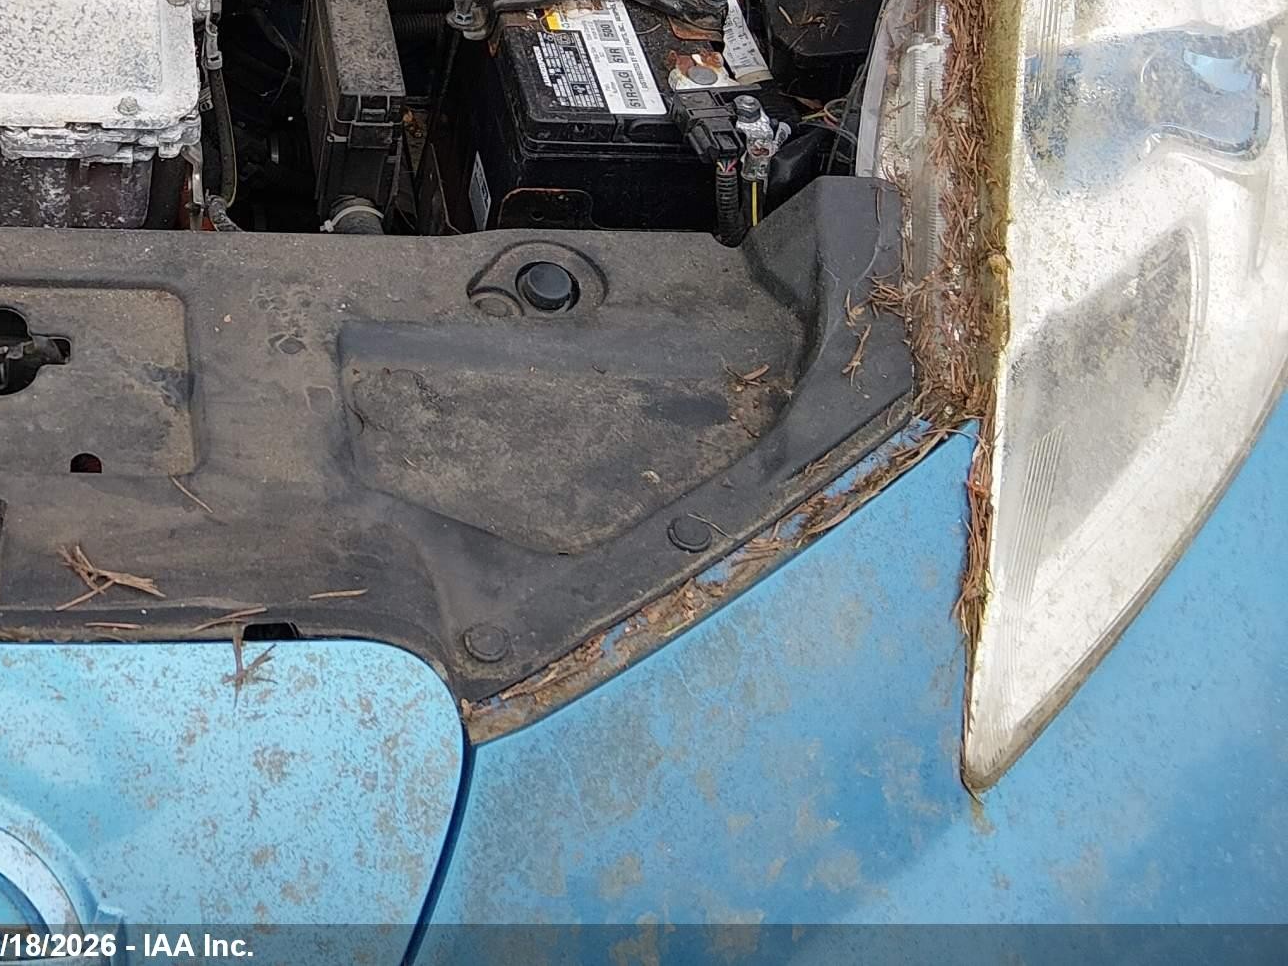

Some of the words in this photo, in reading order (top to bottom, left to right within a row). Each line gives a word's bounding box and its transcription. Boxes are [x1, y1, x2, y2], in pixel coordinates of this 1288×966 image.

[600, 23, 614, 38] 500
[609, 47, 624, 64] 51R
[618, 71, 641, 108] 51R-DLG
